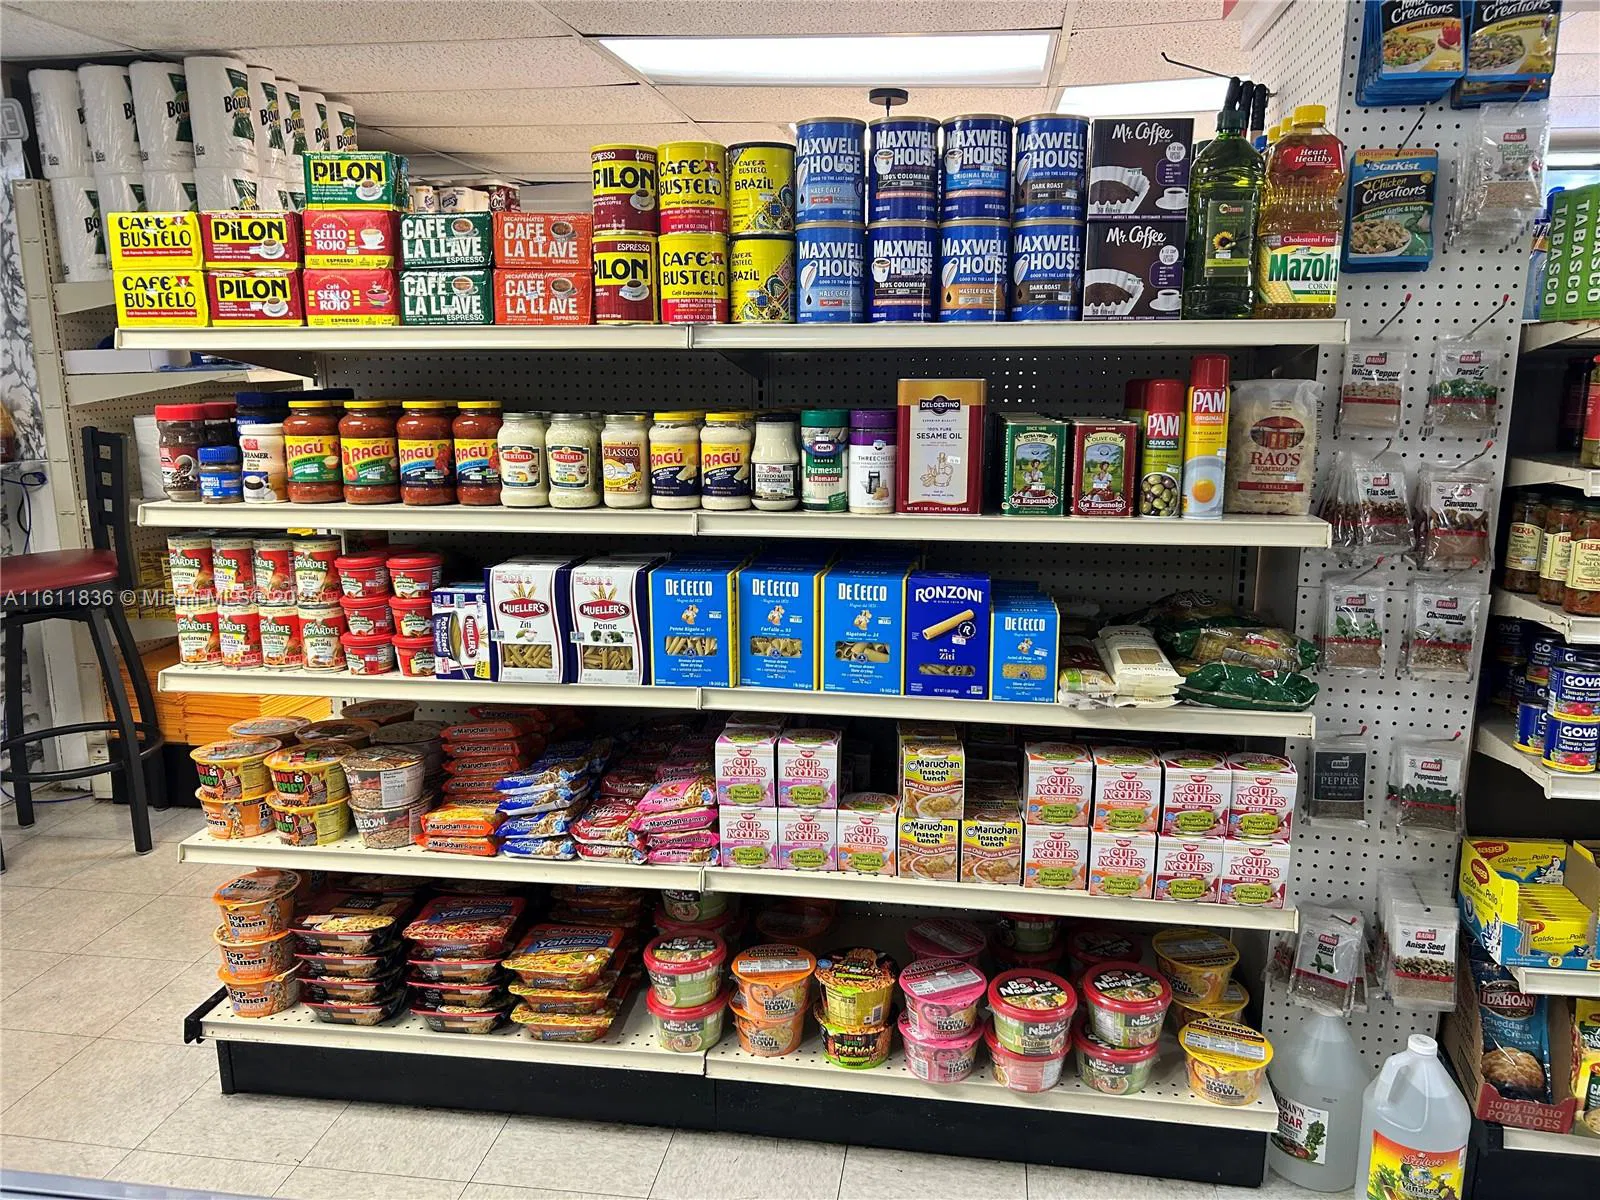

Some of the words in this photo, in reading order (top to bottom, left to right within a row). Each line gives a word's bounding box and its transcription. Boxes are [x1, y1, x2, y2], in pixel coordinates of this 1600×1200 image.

[1390, 2, 1453, 24] Creations
[947, 129, 1008, 149] MAXWELL
[1112, 124, 1134, 140] Mr.
[1135, 122, 1173, 145] Coffee
[876, 130, 935, 149] MAXWELL
[1016, 132, 1084, 152] MAXWELL
[894, 148, 935, 167] HOUSE
[963, 147, 1007, 166] HOUSE
[1300, 148, 1328, 156] Heart
[1032, 150, 1084, 169] HOUSE
[1294, 155, 1333, 164] Healthy
[313, 162, 382, 182] PILON
[1372, 162, 1420, 171] StarKist
[1372, 178, 1407, 191] Chicken
[1362, 185, 1426, 204] Creations
[215, 221, 284, 241] PILON
[402, 219, 446, 239] CAFE
[504, 223, 544, 239] CAFE
[120, 230, 191, 247] BUSTELO
[314, 230, 347, 240] SELLO
[1106, 228, 1127, 244] Mr.
[1129, 226, 1167, 249] Coffee
[1283, 235, 1320, 243] Cholesterol
[316, 240, 345, 250] ROJO
[504, 242, 525, 257] LA
[529, 241, 578, 258] LLAVE
[617, 243, 650, 252] ESPRESSO
[873, 240, 933, 257] MAXWELL
[1545, 204, 1568, 305] TABASCO
[1566, 200, 1590, 304] TABASCO
[446, 256, 484, 264] ESPRESSO
[1030, 253, 1080, 270] HOUSE
[664, 270, 725, 286] BUSTELO
[220, 280, 288, 299] PILON
[124, 292, 196, 308] BUSTELO
[319, 300, 349, 311] ROJO
[405, 297, 427, 316] LA
[431, 296, 482, 315] LLAVE
[1192, 390, 1225, 413] PAM
[1147, 415, 1180, 436] PAM
[553, 453, 582, 461] BERTOLLI
[604, 447, 639, 457] CLASSICO
[1250, 452, 1300, 466] RAO'S
[807, 466, 841, 474] Parmesan
[1380, 488, 1396, 496] Seed
[915, 586, 982, 603] RONZONI
[502, 602, 545, 613] MUELLER'S
[583, 604, 626, 615] MUELLER'S
[593, 622, 617, 630] Penne
[939, 653, 955, 661] Ziti
[1562, 725, 1598, 737] GOYA
[732, 758, 757, 768] CUP
[916, 760, 960, 769] Maruchan
[276, 770, 295, 783] HOT
[723, 766, 766, 777] NOODLES
[1414, 772, 1448, 782] Peppermint
[1047, 776, 1074, 786] CUP
[1321, 777, 1359, 785] PEPPER
[278, 782, 304, 793] SPICY
[1036, 785, 1083, 796] NOODLES
[1249, 787, 1278, 797] CUP
[430, 822, 461, 831] Maruchan
[737, 821, 761, 831] CUP
[911, 822, 954, 832] Maruchan
[975, 825, 1018, 834] Maruchan
[727, 829, 769, 840] NOODLES
[1044, 840, 1070, 850] CUP
[1033, 849, 1079, 860] NOODLES
[1242, 857, 1271, 867] CUP
[1230, 866, 1279, 877] NOODLES
[226, 913, 245, 923] Top
[439, 906, 507, 919] Yakisoba
[229, 919, 267, 928] Ramen
[536, 936, 604, 948] Yakisoba
[1406, 940, 1426, 950] Anise
[1427, 941, 1446, 951] Seed
[225, 950, 244, 959] Top
[227, 957, 267, 966] Ramen
[1482, 992, 1534, 1007] IDAHOAN
[937, 1023, 968, 1031] BOWL
[1484, 1016, 1524, 1030] Cheddar
[1232, 1027, 1258, 1036] BOWL
[1206, 1084, 1240, 1096] BOWL
[1522, 1106, 1563, 1118] IDAHO
[1488, 1111, 1561, 1130] POTATOES
[1402, 1181, 1440, 1194] Vinagre
